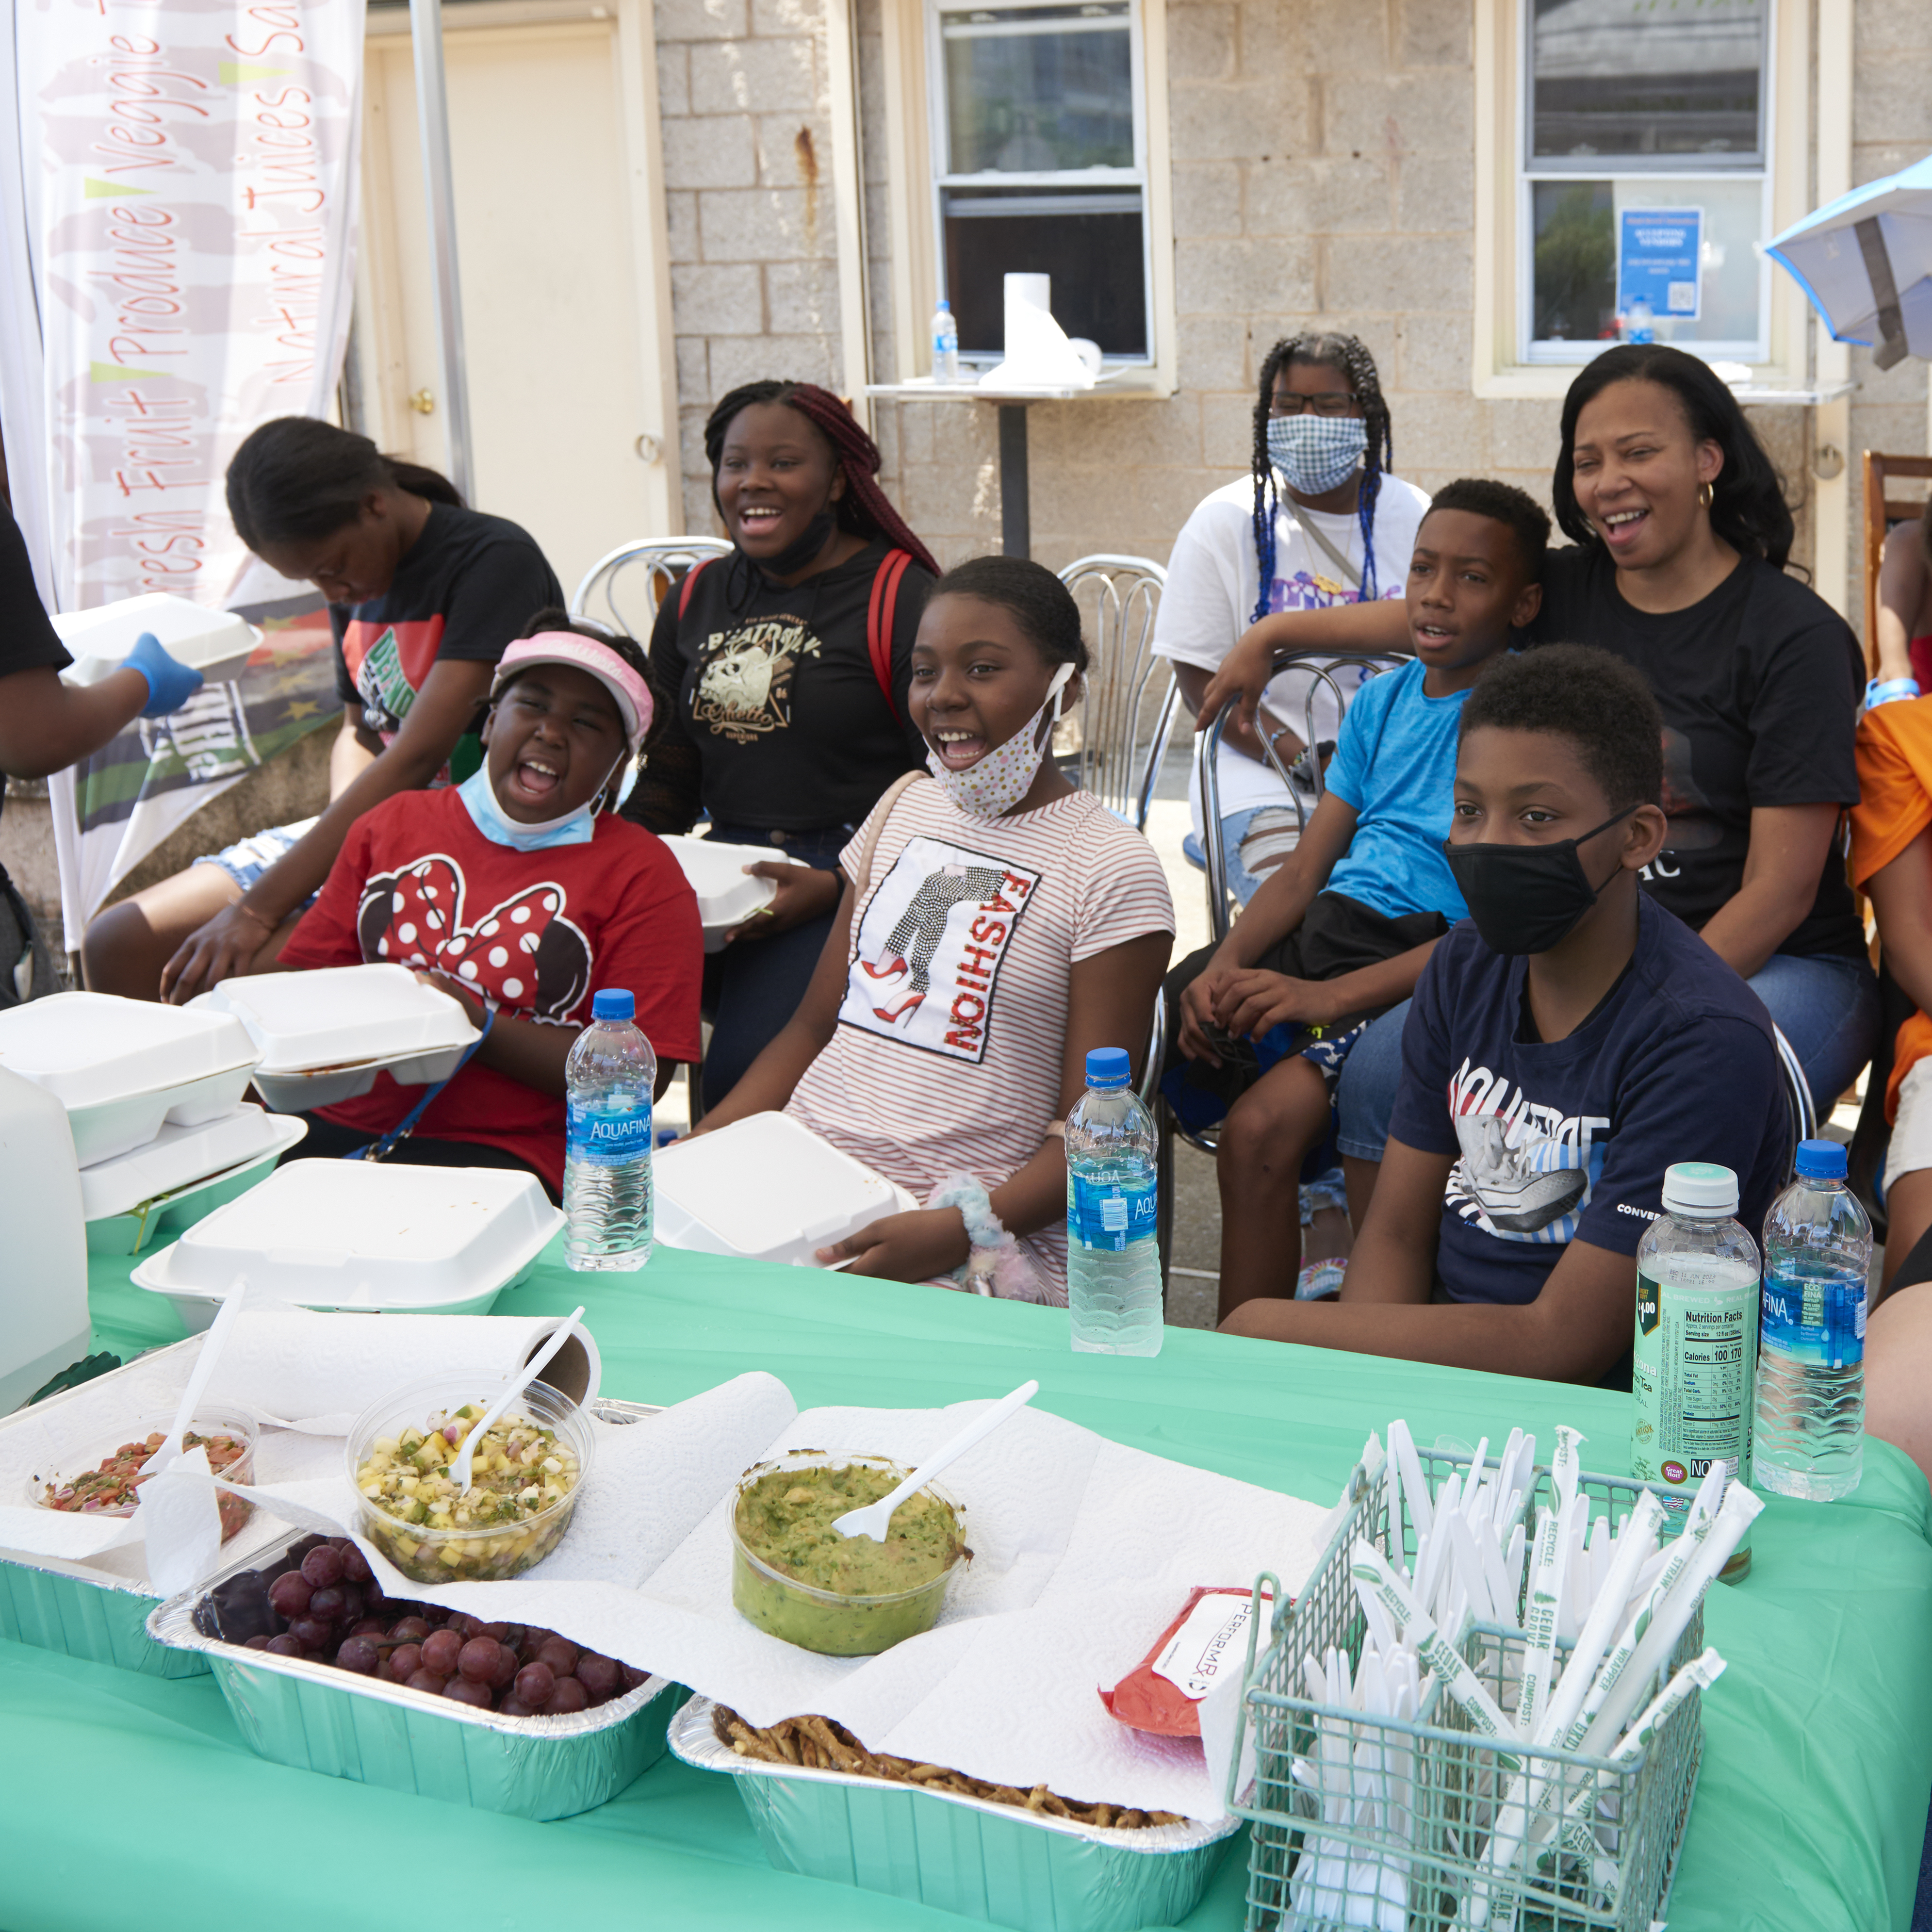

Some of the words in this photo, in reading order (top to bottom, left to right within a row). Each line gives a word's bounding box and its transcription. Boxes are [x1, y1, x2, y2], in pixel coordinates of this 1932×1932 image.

[91, 34, 209, 173] Veggie
[236, 87, 325, 213] Juices
[87, 205, 189, 363] Produce
[235, 228, 324, 384] Natural
[104, 390, 211, 497] Fruit
[110, 510, 207, 592] resh
[701, 700, 776, 727] Ghetto
[944, 869, 1032, 1053] FASHION
[589, 1114, 652, 1140] AQUAFINA
[1135, 1191, 1158, 1220] AQUA
[1617, 1203, 1661, 1221] CONVER
[1673, 1293, 1710, 1304] BREWED
[1726, 1294, 1743, 1303] REAL
[1762, 1290, 1788, 1323] AFINA
[1804, 1291, 1822, 1299] FINA
[1686, 1311, 1722, 1323] Nutrition
[1724, 1310, 1742, 1322] Facts
[1685, 1351, 1710, 1361] Calories
[1715, 1350, 1727, 1361] 100
[1731, 1347, 1741, 1359] 170
[1640, 1375, 1652, 1392] Tea
[1666, 1466, 1682, 1474] Great
[1691, 1460, 1711, 1476] NO
[1544, 1521, 1558, 1567] RECYCLE:
[1660, 1555, 1683, 1589] STRAW
[1383, 1584, 1412, 1622] RECYCLE:
[1536, 1609, 1554, 1650] CEDAR
[1434, 1640, 1464, 1680] CEDAR
[1598, 1647, 1630, 1691] WRAPPER
[1467, 1696, 1497, 1737] COMPOST:
[1520, 1674, 1537, 1726] COMPOST:
